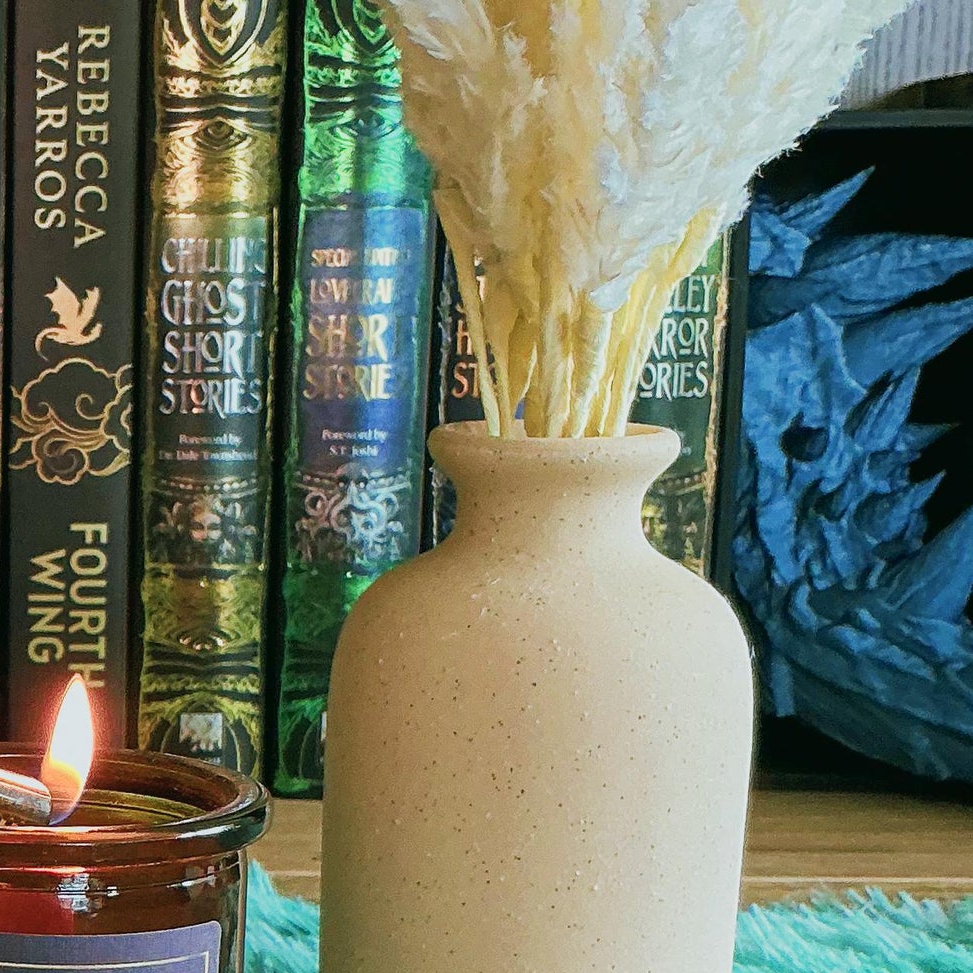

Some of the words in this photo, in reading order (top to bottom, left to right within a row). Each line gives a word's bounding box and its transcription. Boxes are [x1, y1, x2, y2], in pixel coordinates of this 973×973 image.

[34, 42, 70, 230] YARROS
[73, 25, 111, 249] REBECCA
[160, 278, 267, 326] GHOST
[162, 329, 263, 380] SHORT
[159, 378, 263, 420] STORIES
[27, 549, 66, 664] WING
[68, 522, 108, 688] FOURTH
